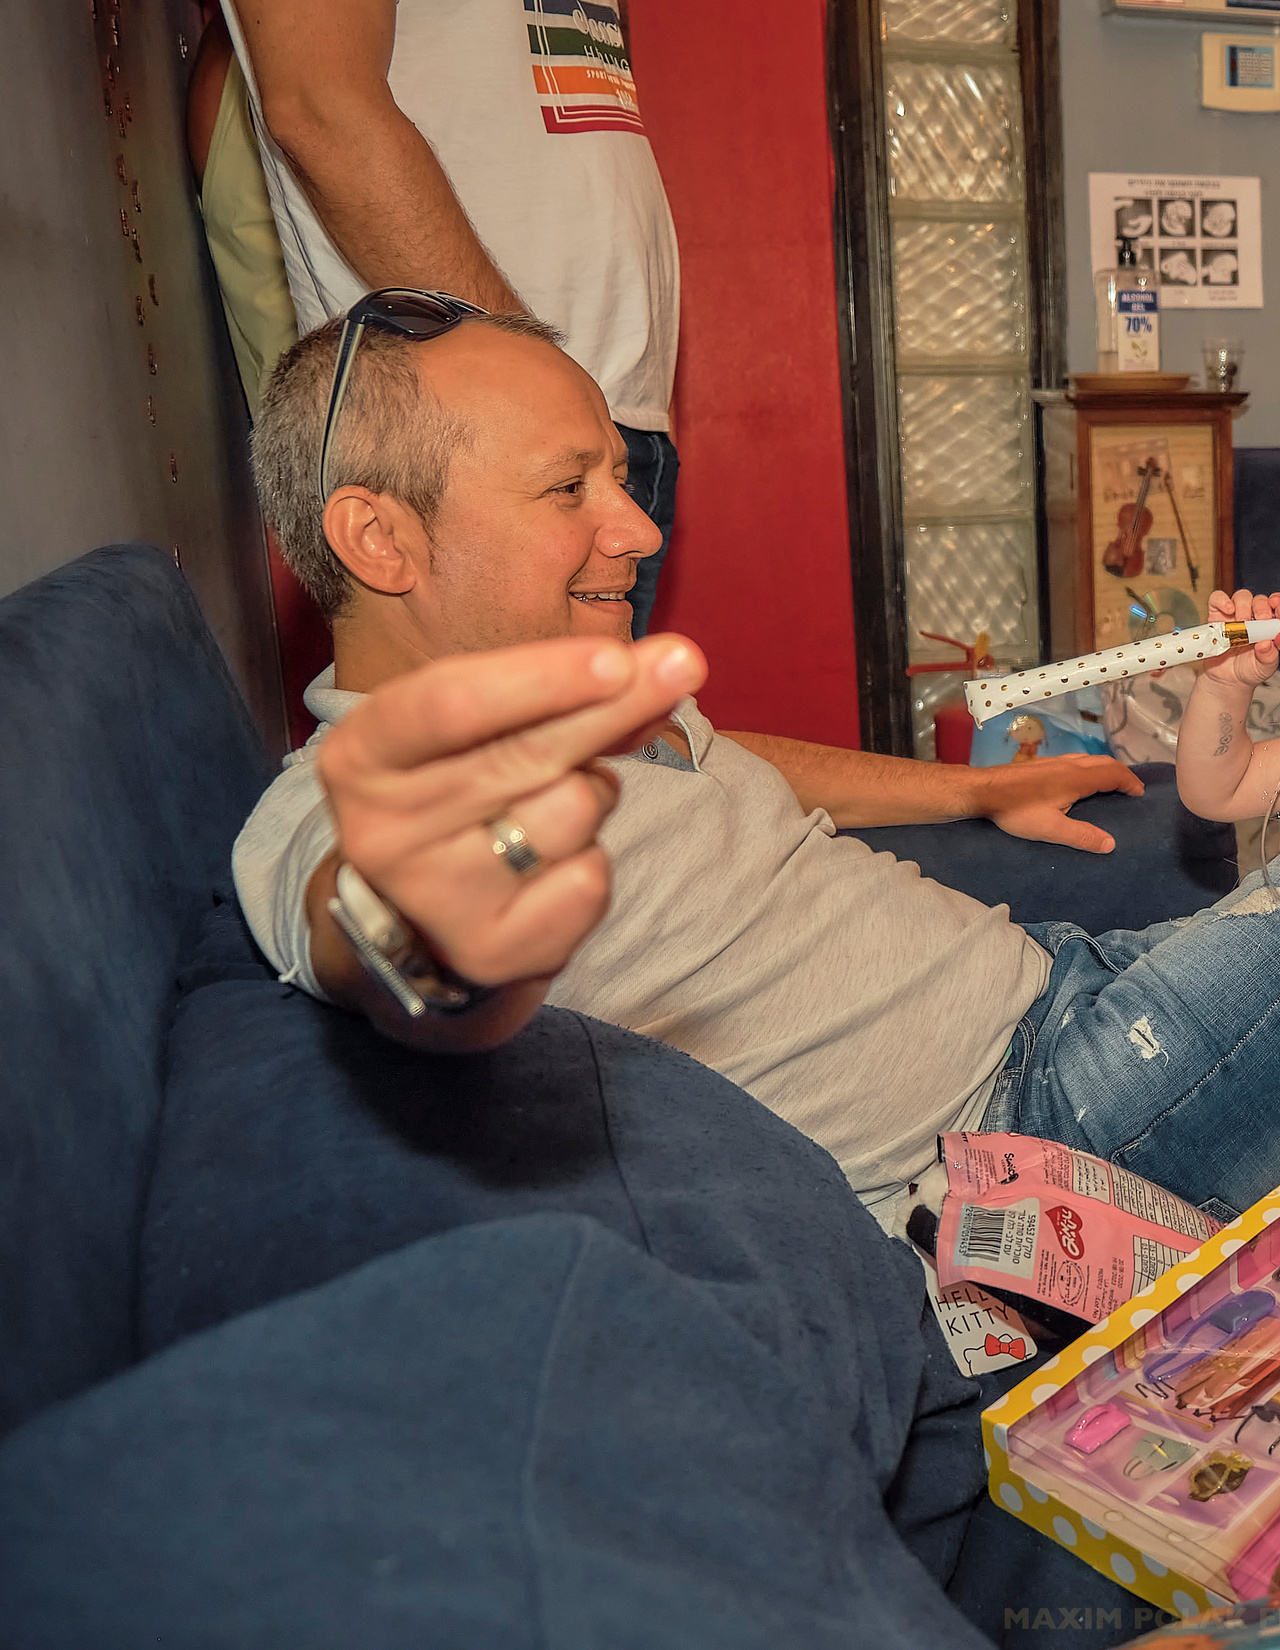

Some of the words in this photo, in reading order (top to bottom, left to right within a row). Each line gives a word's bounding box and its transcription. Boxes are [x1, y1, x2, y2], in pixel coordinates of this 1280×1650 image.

[1121, 293, 1154, 303] ALCOHOL
[1131, 303, 1146, 311] GEL
[1125, 316, 1152, 333] 70%
[1027, 1215, 1036, 1236] 59453
[1003, 1244, 1012, 1255] עם
[1013, 1237, 1023, 1264] סוכריות
[945, 1305, 1009, 1337] KITTY
